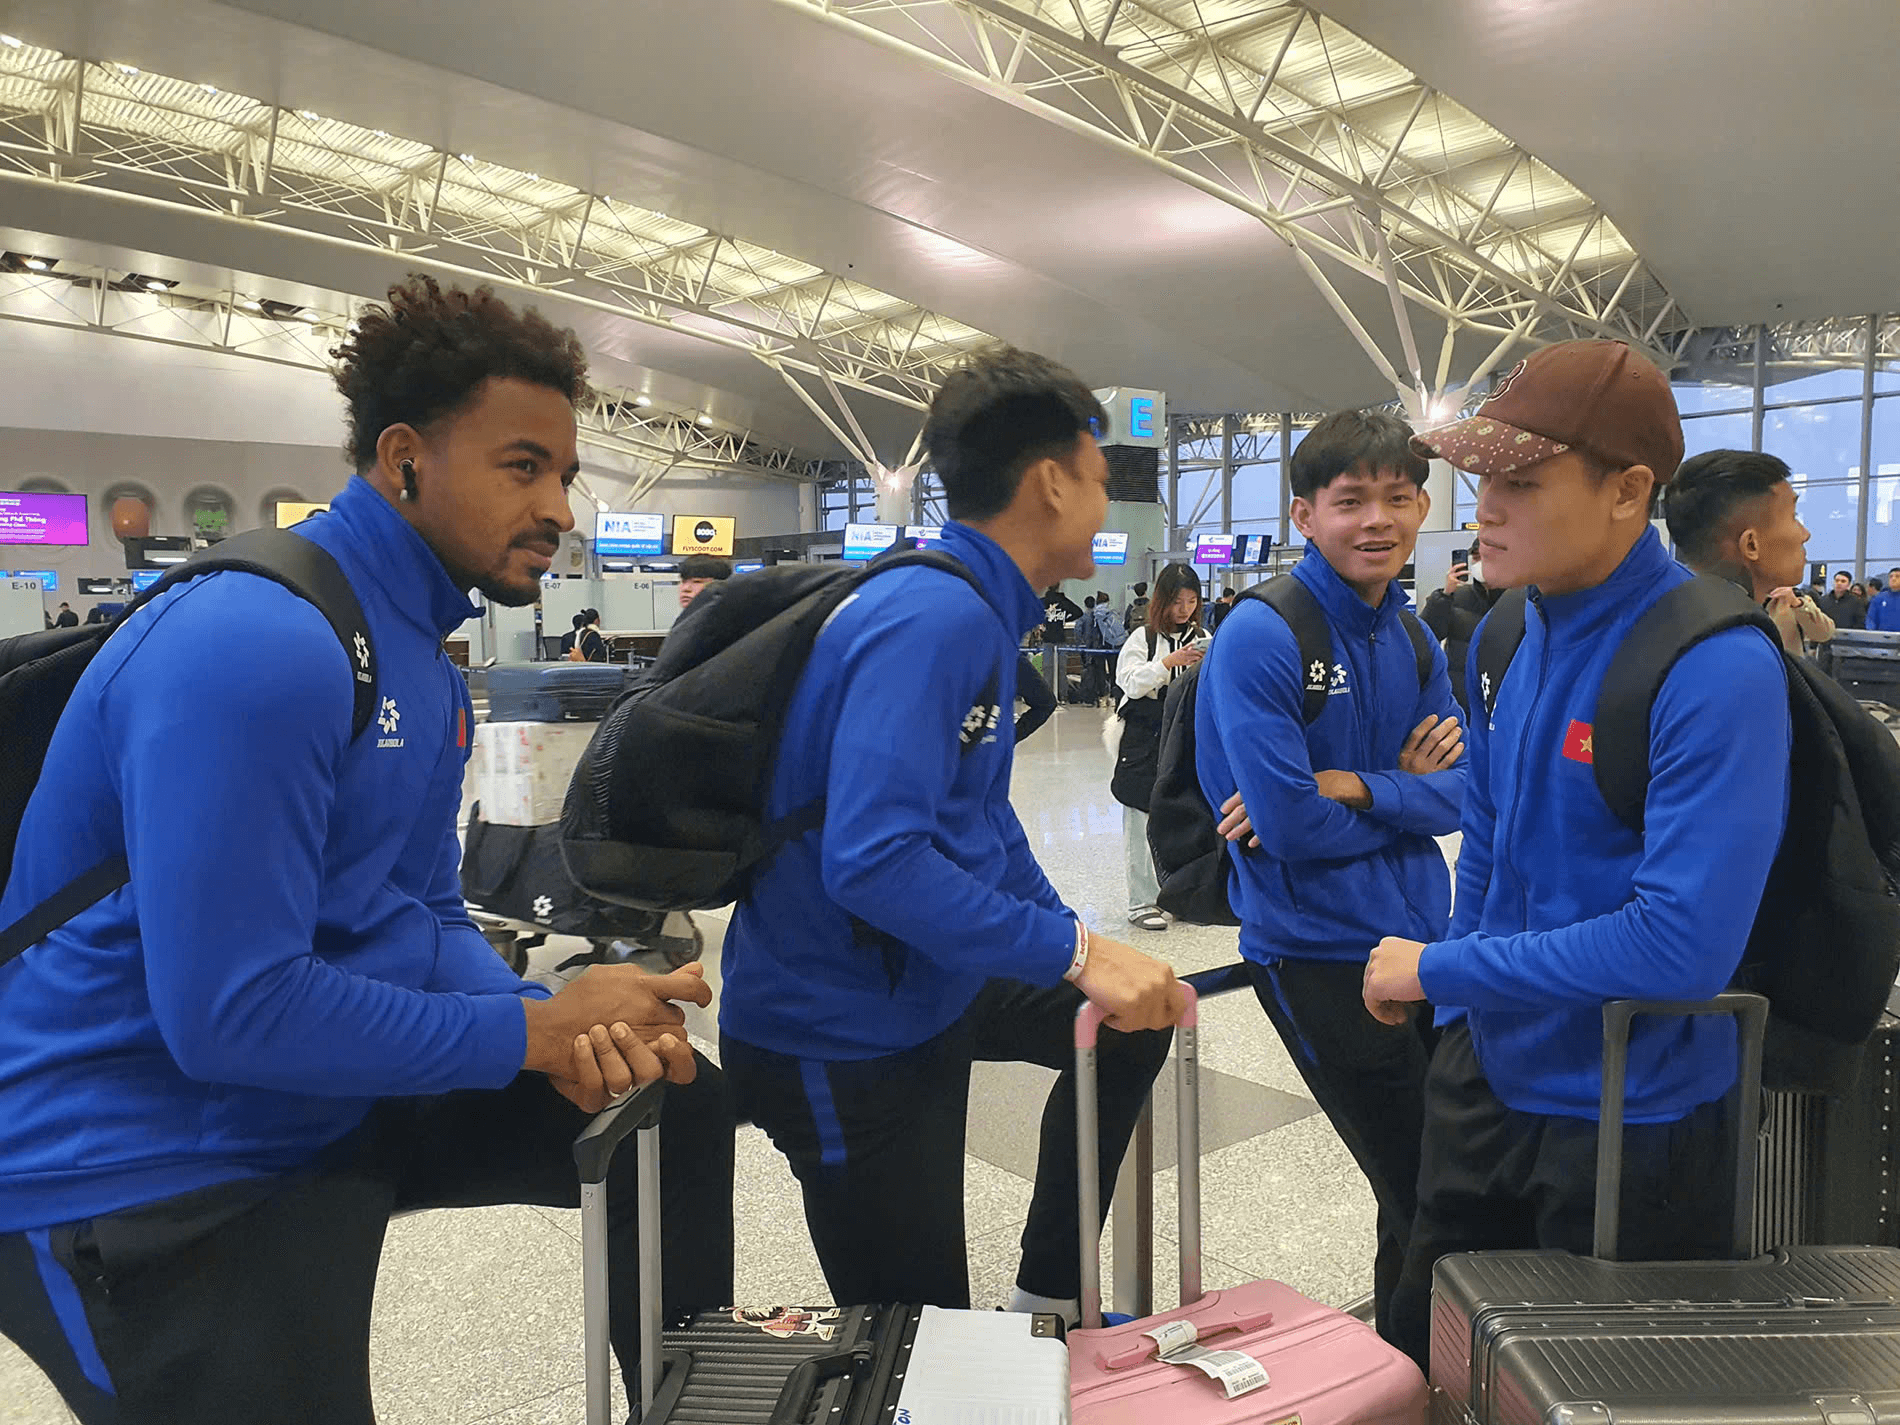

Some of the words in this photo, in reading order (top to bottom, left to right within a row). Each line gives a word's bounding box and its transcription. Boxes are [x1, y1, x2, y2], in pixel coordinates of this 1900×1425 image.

[1130, 397, 1154, 438] E
[604, 520, 632, 533] NIA
[11, 582, 37, 590] E-10
[544, 582, 561, 590] E-07
